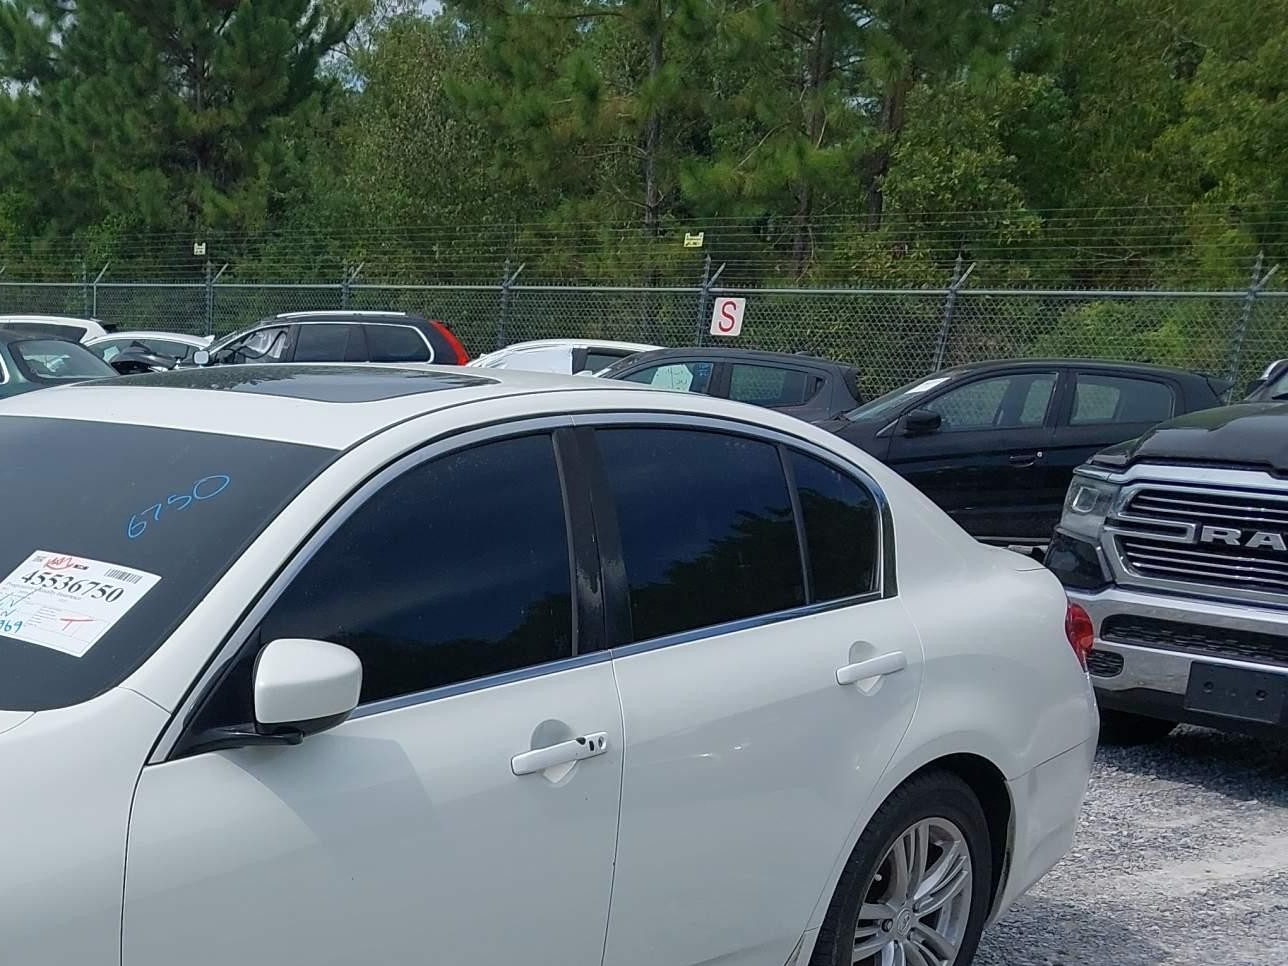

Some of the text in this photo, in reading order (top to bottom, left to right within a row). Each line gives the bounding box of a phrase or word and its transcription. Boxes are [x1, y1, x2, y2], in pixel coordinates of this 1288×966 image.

[718, 300, 737, 332] S
[127, 474, 231, 539] 6750
[20, 569, 125, 603] 45536750
